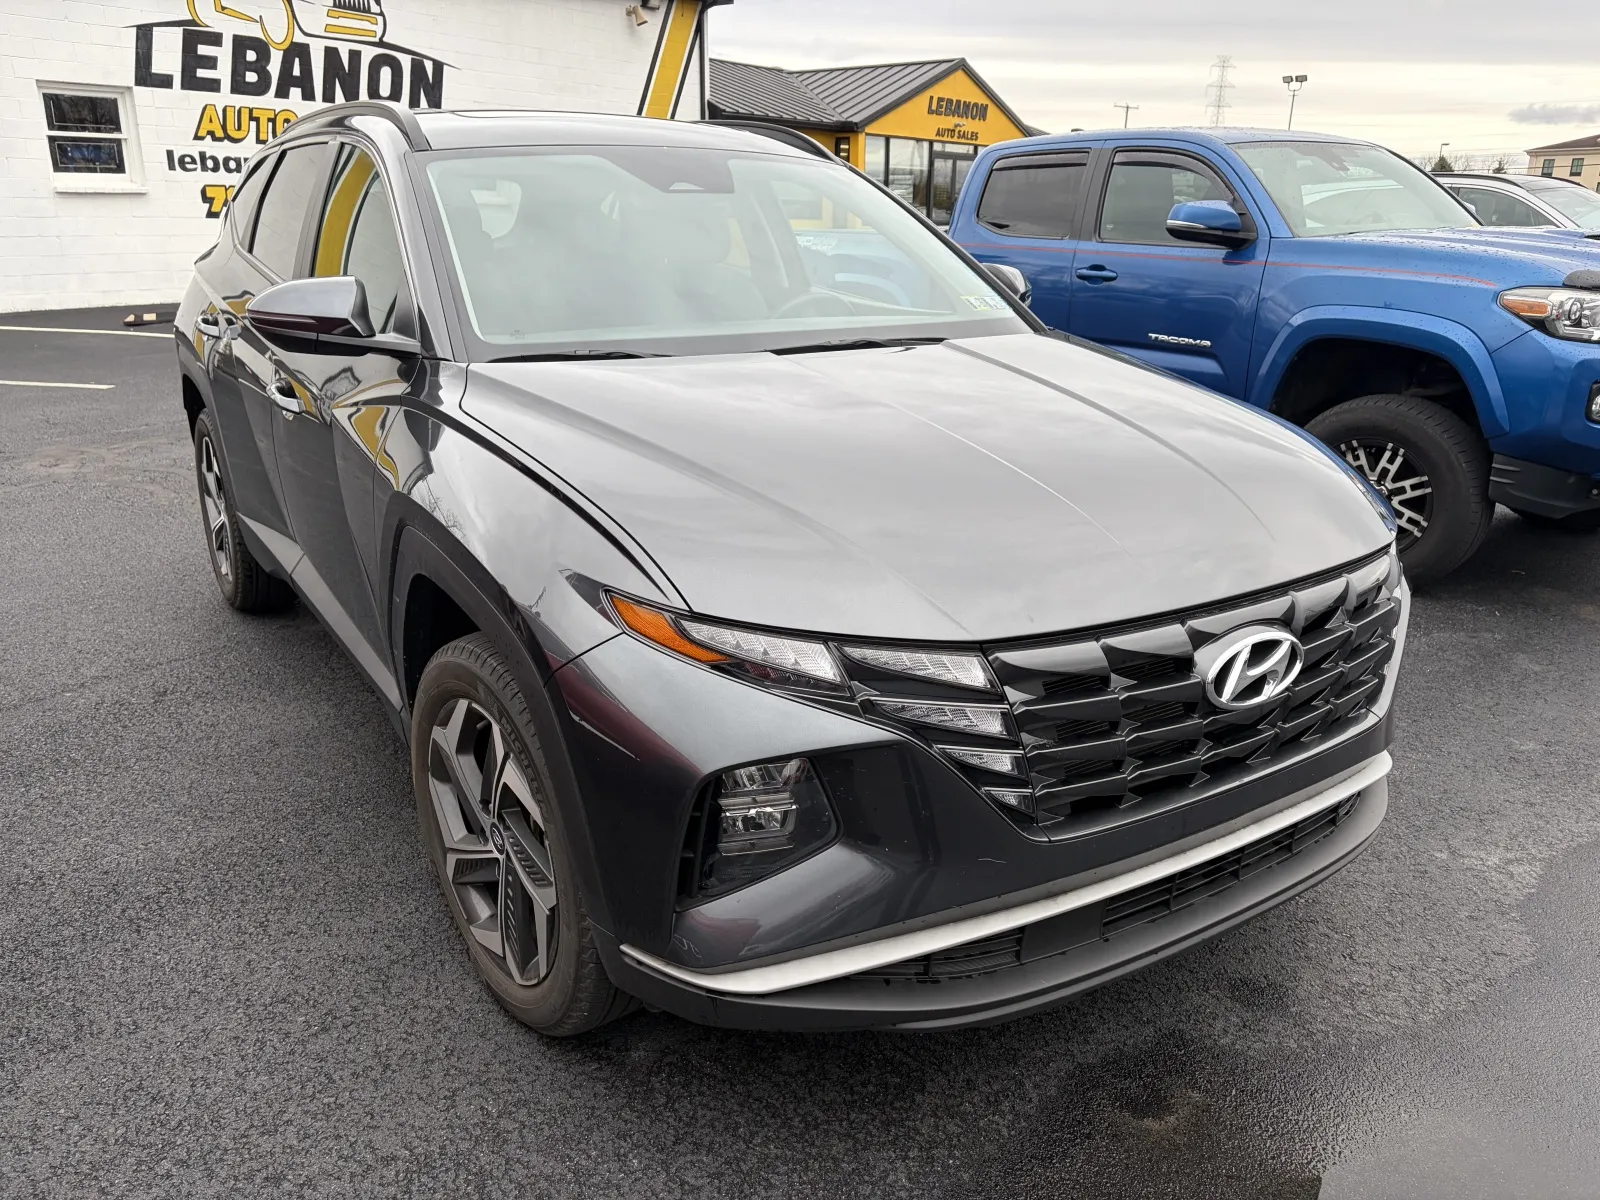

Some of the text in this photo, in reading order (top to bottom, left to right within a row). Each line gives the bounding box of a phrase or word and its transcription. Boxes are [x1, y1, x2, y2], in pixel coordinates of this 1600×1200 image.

[134, 26, 444, 109] LEBANON
[928, 95, 989, 121] LEBANON
[935, 127, 979, 141] AUTO SALES
[166, 149, 250, 174] leba
[1148, 333, 1212, 347] TACOMA
